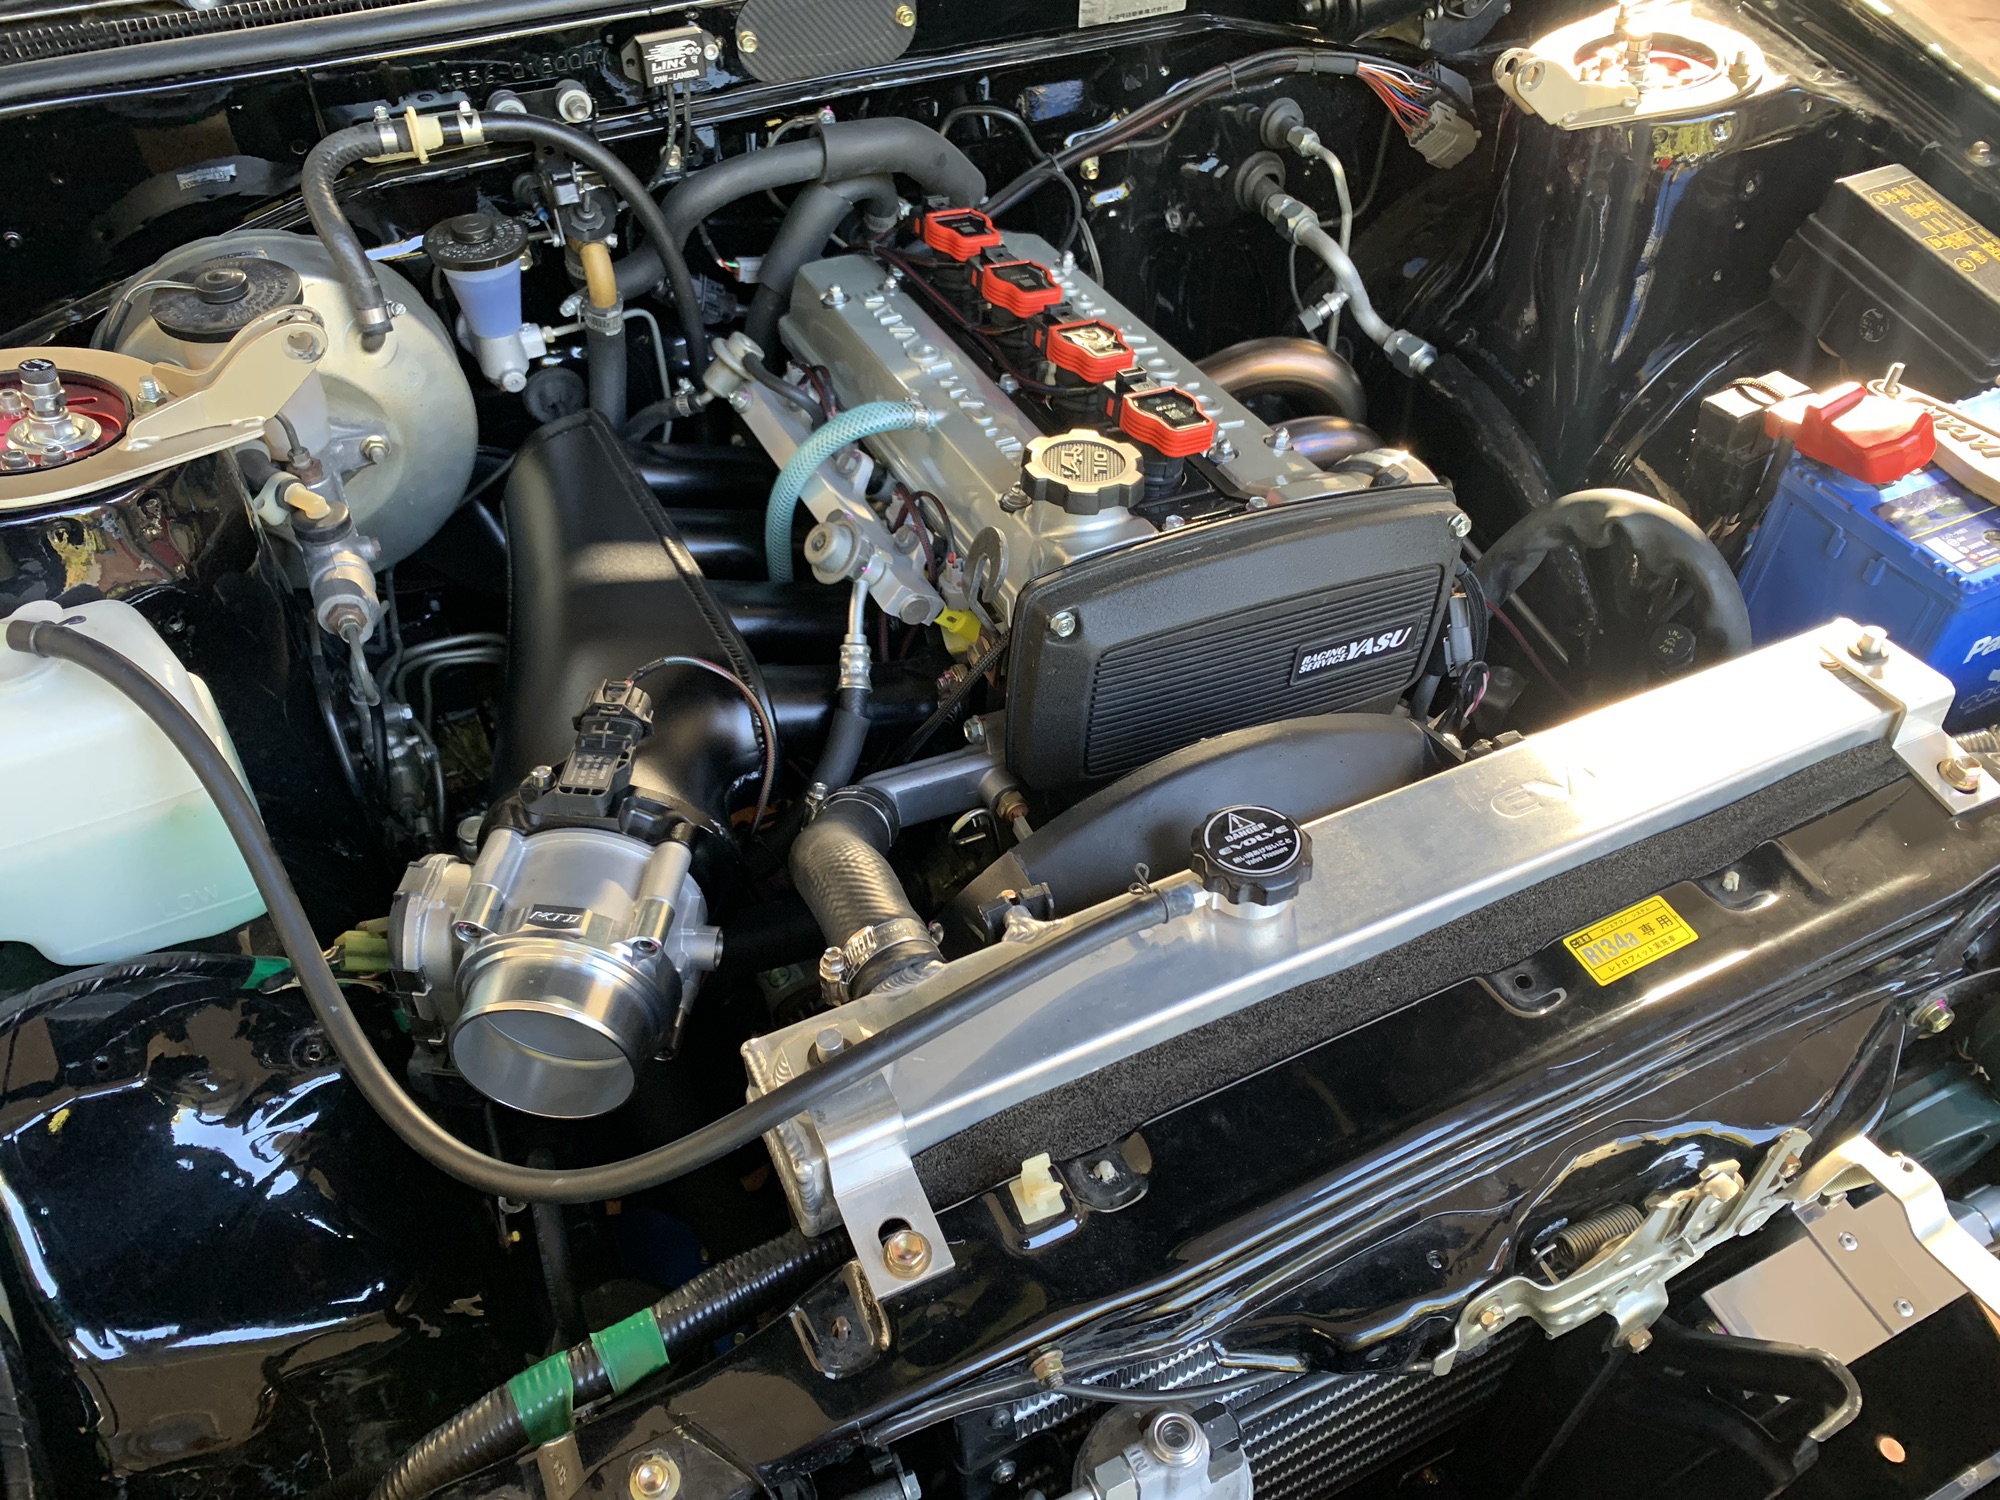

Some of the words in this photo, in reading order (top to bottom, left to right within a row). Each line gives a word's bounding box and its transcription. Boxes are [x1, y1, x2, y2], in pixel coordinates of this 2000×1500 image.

[651, 57, 688, 72] LINK
[1094, 450, 1107, 476] OIL
[1301, 645, 1348, 666] RACING
[1346, 626, 1412, 661] YASU
[1298, 652, 1349, 674] SERVICE
[1218, 825, 1289, 856] EVOLVE
[1224, 822, 1268, 843] DANGER
[157, 883, 219, 918] LOW
[1581, 931, 1641, 967] R134a
[1129, 1449, 1149, 1473] IN
